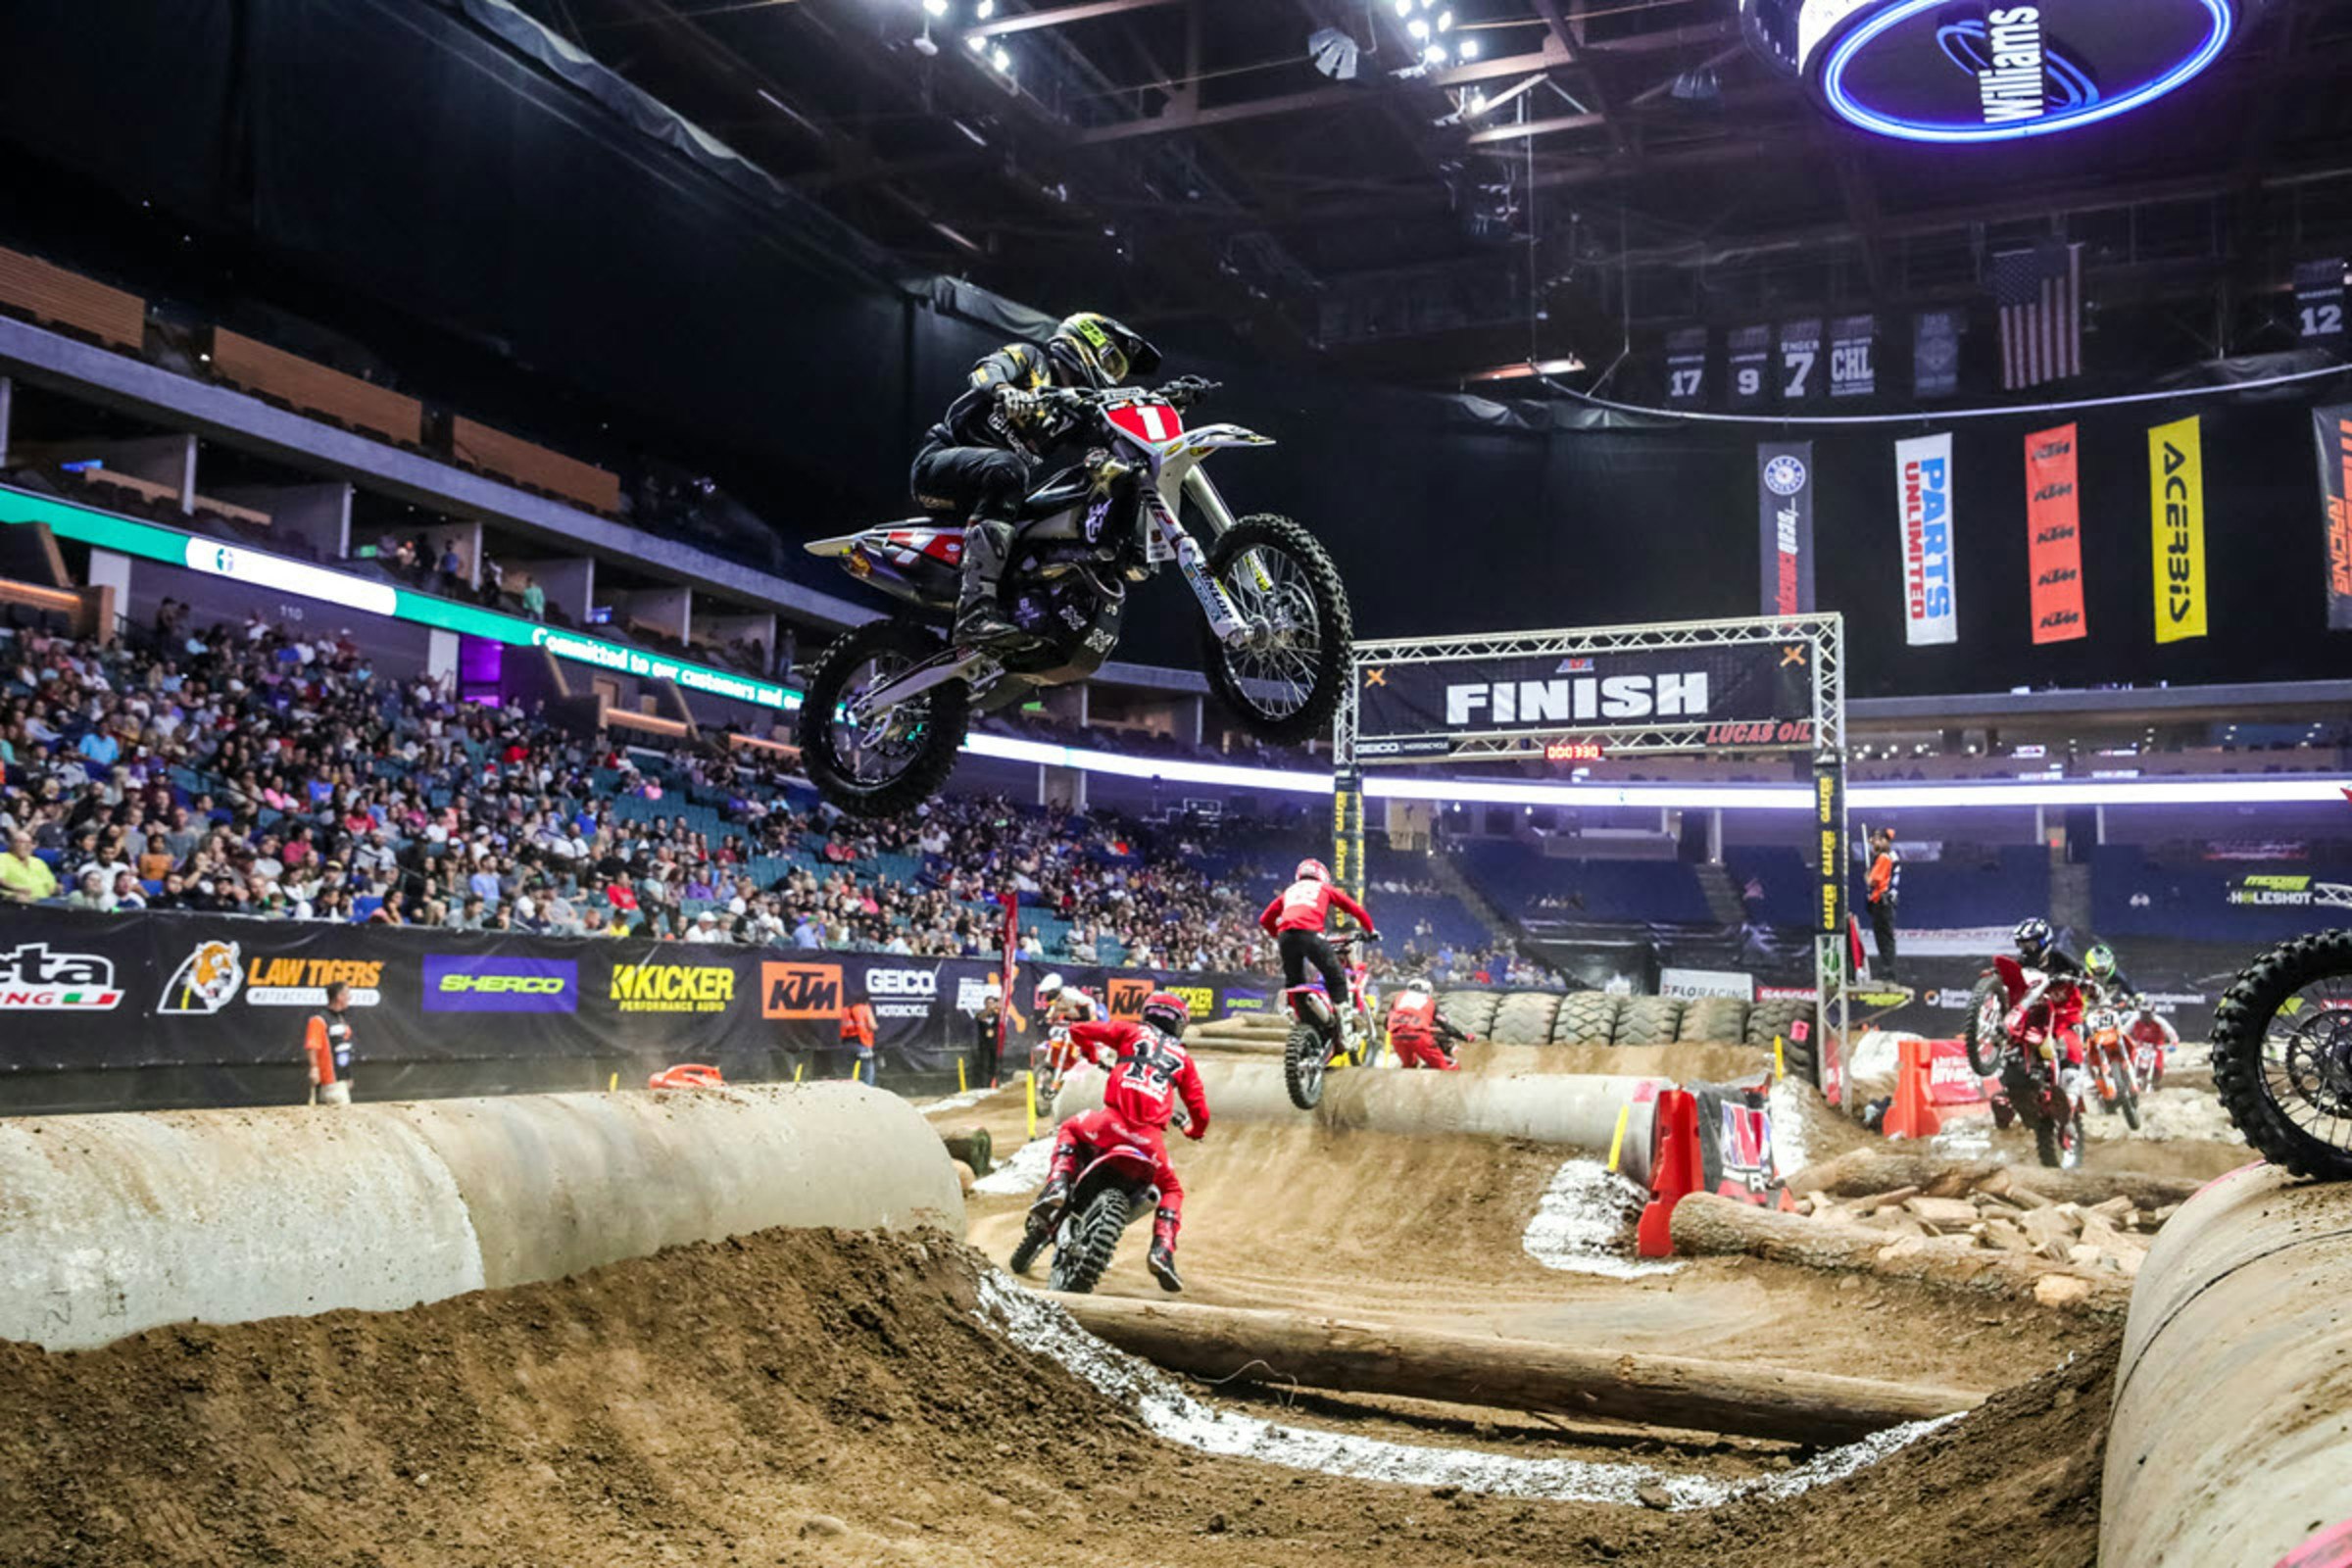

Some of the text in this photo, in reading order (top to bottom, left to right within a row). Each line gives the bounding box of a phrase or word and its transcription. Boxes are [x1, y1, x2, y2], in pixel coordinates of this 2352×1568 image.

[1979, 6, 2044, 123] Williams
[2300, 304, 2343, 336] 12
[1785, 352, 1815, 398] 7
[1831, 346, 1875, 382] CHL
[1670, 369, 1702, 397] 17
[1739, 368, 1759, 396] 9
[1137, 407, 1167, 441] 1
[2033, 442, 2071, 461] KTM
[2034, 483, 2073, 502] KTM
[1904, 461, 1926, 620] UNLIMITED
[1921, 458, 1950, 618] PARTS
[2037, 524, 2075, 543] KTM
[2327, 494, 2352, 596] RACING
[2038, 568, 2077, 586] KTM
[2040, 611, 2080, 628] KTM
[532, 627, 628, 670] Committed
[630, 654, 650, 674] to
[652, 662, 679, 679] our
[681, 670, 756, 701] customers
[758, 688, 783, 707] and
[1446, 671, 1708, 725] FINISH
[1355, 742, 1399, 755] GEICO
[1706, 721, 1812, 745] LUCAS OIL
[1335, 791, 1347, 832] GALFER
[1819, 777, 1833, 823] GALFER
[1335, 839, 1347, 880] GALFER
[1821, 830, 1835, 876] GALFER
[1822, 884, 1837, 930] GALFER
[247, 956, 384, 988] LAW TIGERS
[439, 974, 565, 995] SHERCO
[865, 967, 937, 995] GEICO
[768, 970, 838, 1011] KTM
